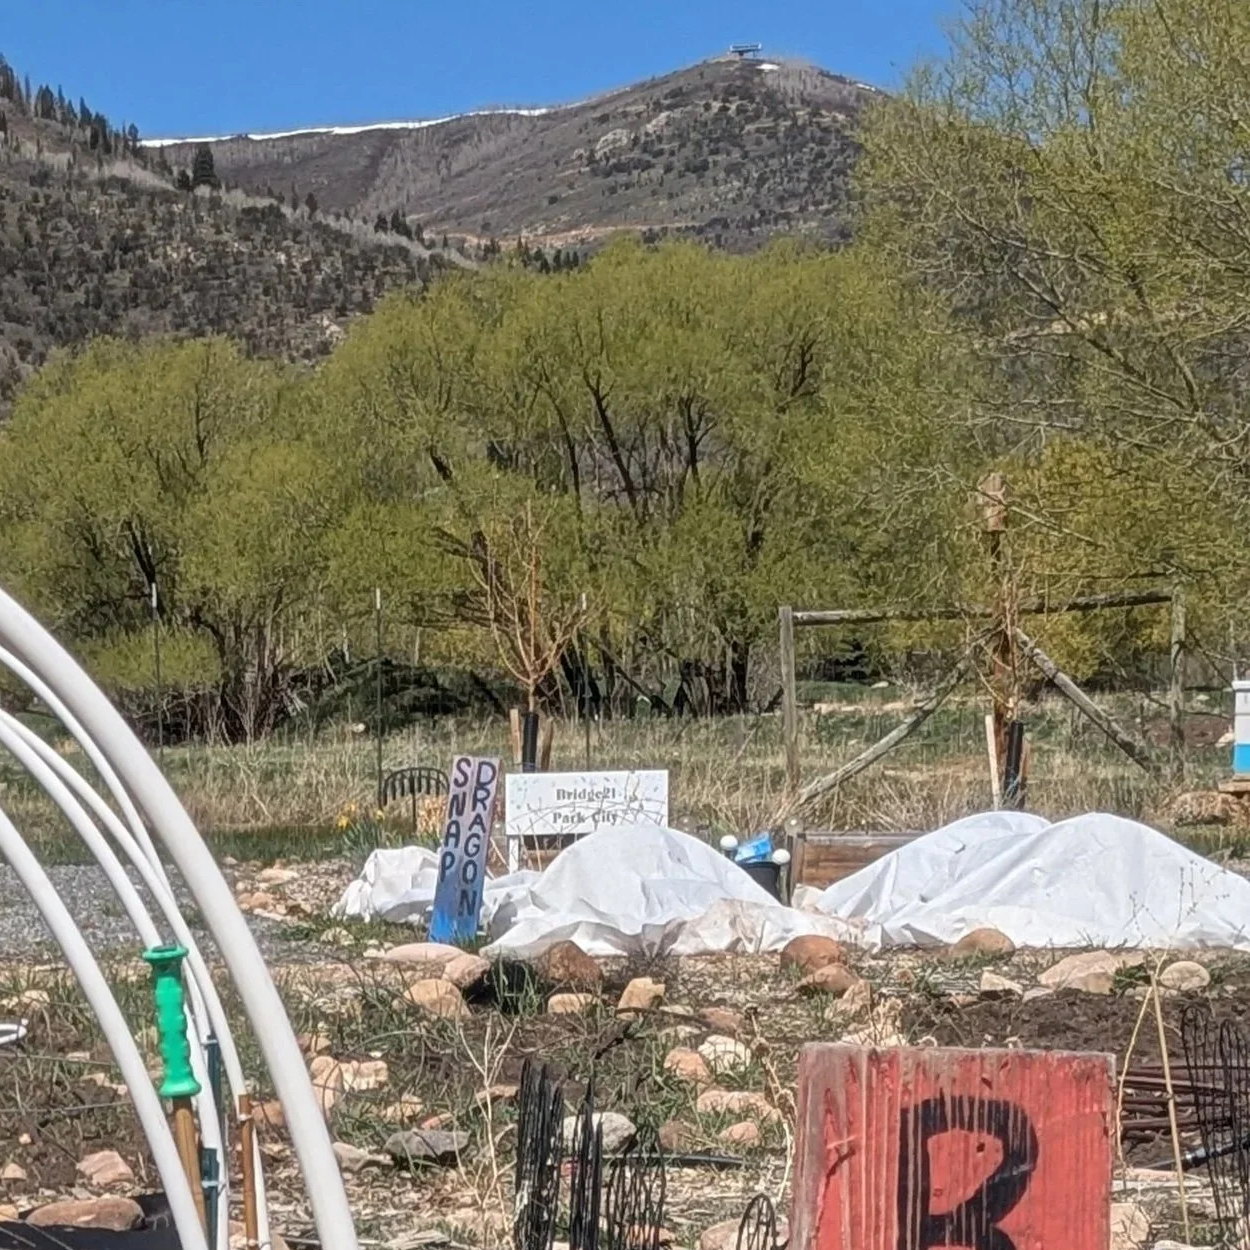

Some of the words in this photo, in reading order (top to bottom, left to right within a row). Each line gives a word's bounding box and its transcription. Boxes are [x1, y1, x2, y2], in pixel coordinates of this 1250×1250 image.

[440, 757, 472, 883] SNAP
[553, 811, 586, 824] Park
[592, 811, 618, 826] City
[556, 787, 616, 801] Bridge21
[458, 761, 497, 917] DRAGON
